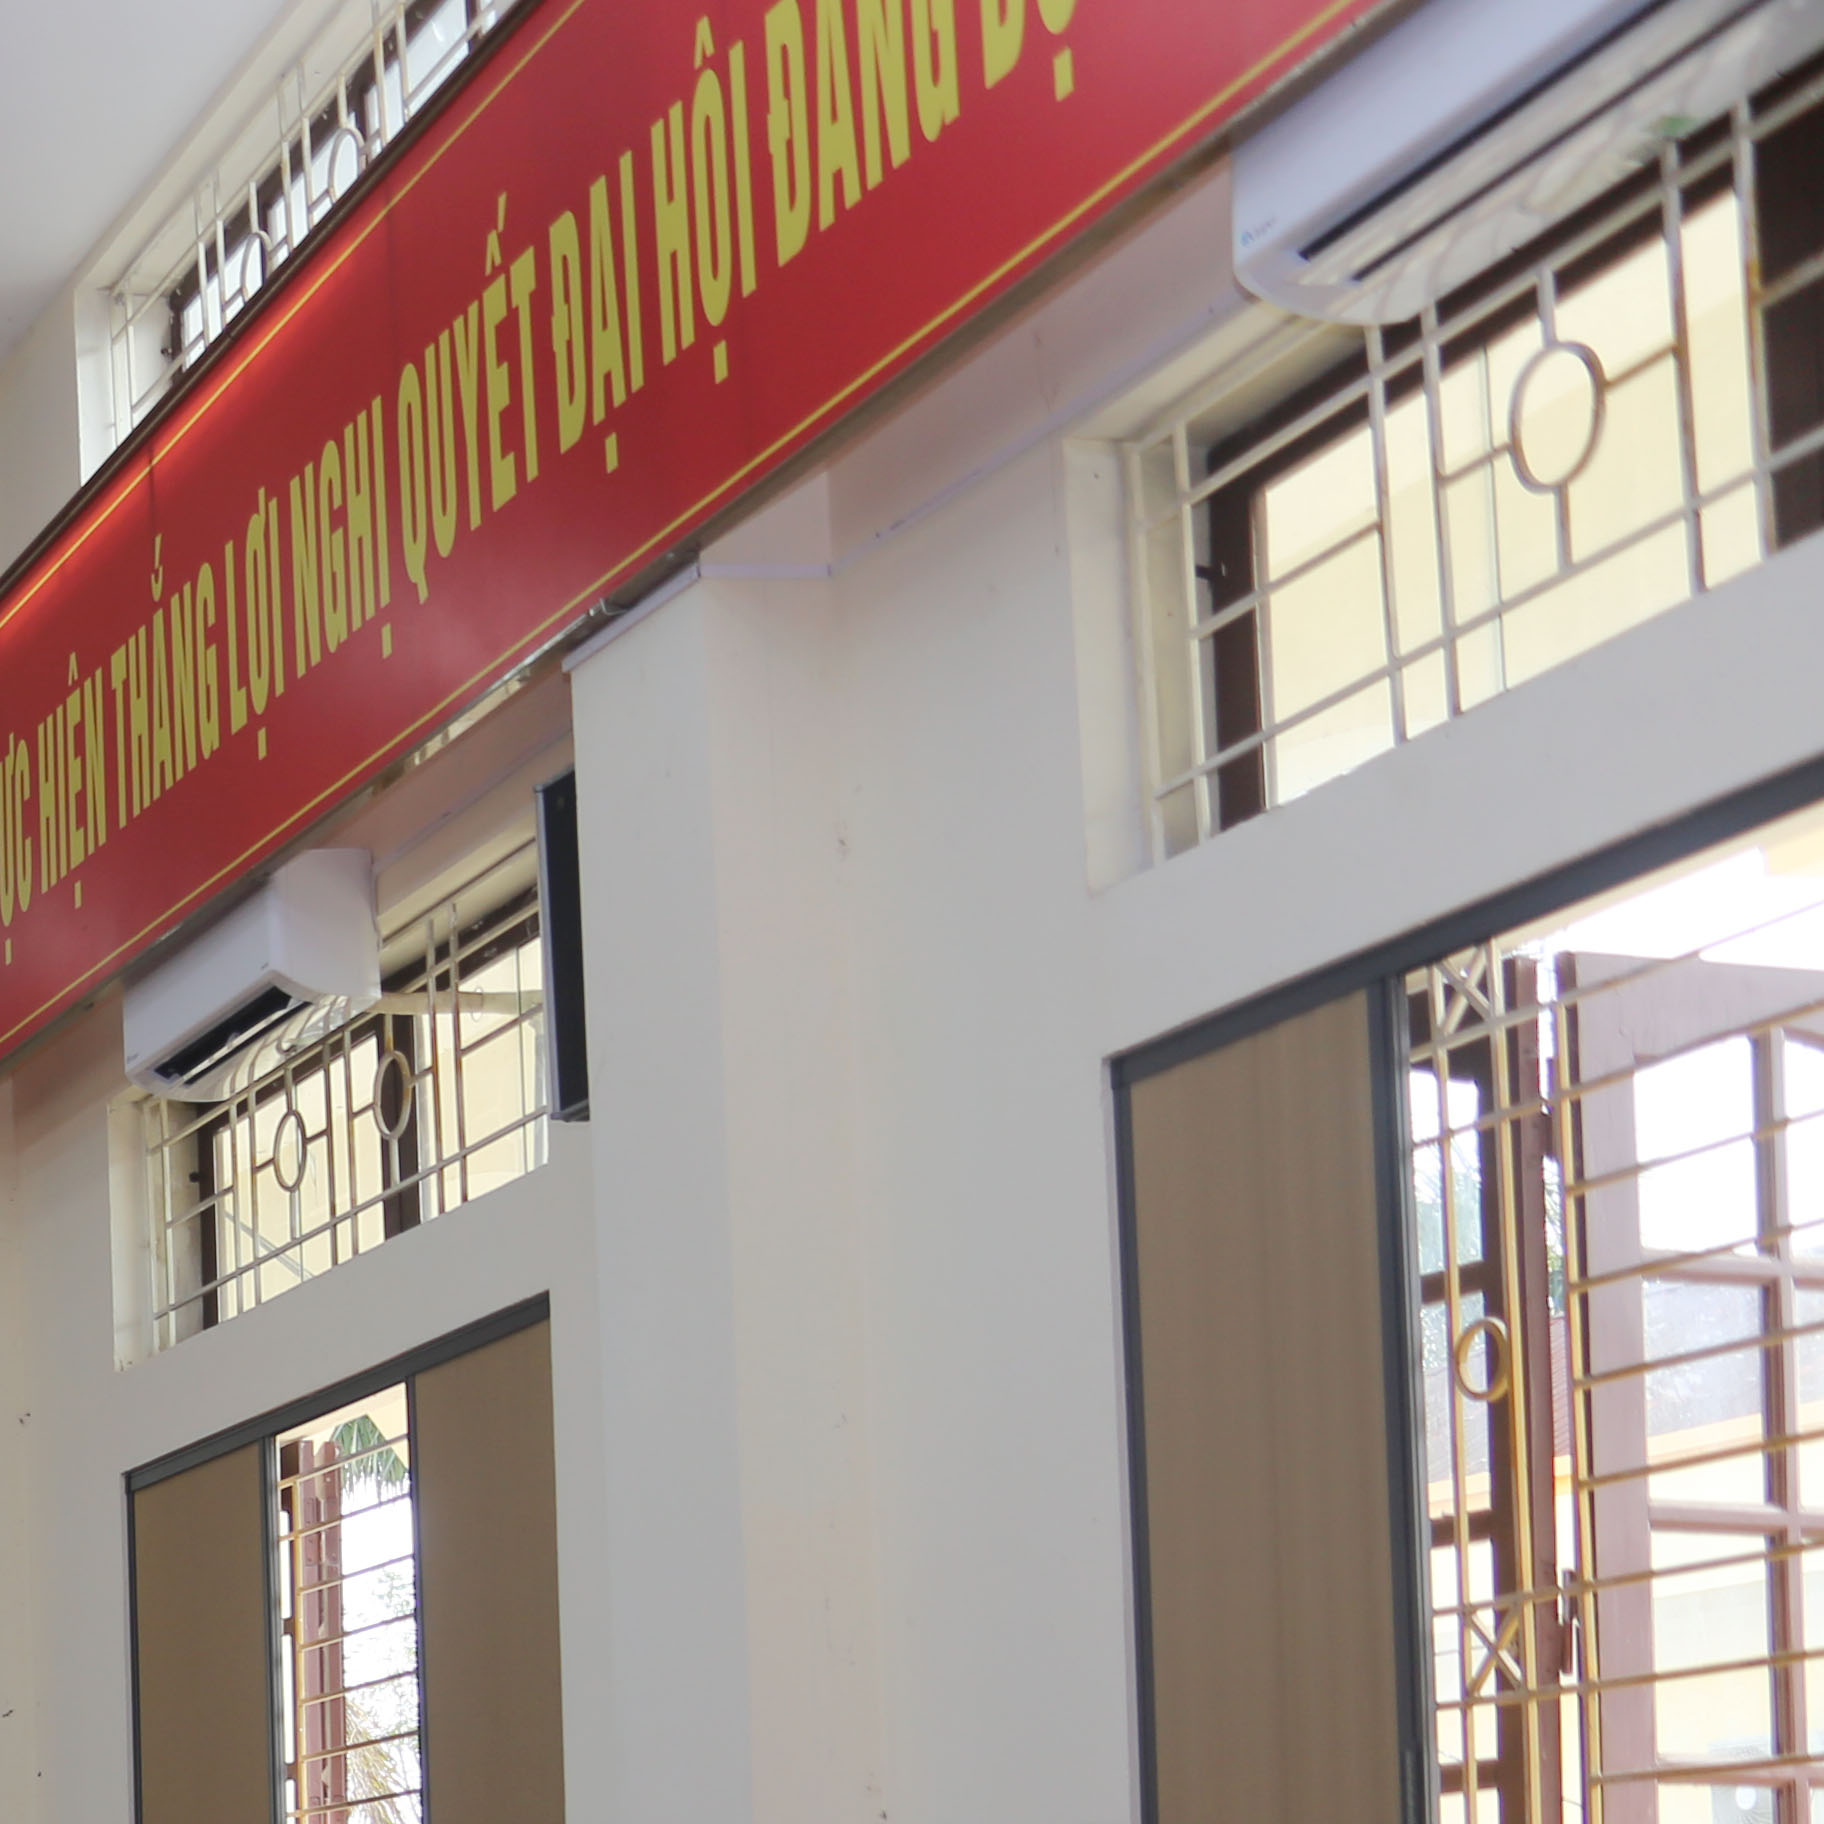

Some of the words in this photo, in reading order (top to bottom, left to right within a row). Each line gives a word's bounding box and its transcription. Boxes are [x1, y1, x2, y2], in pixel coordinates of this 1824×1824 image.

[37, 651, 107, 910] HIỆN
[111, 534, 220, 830] THẮNG
[225, 487, 285, 761] LỢI
[290, 395, 393, 660] NGHỊ
[397, 191, 539, 605] QUYẾT
[549, 149, 645, 475] ĐẠI
[650, 15, 757, 385] HỘI
